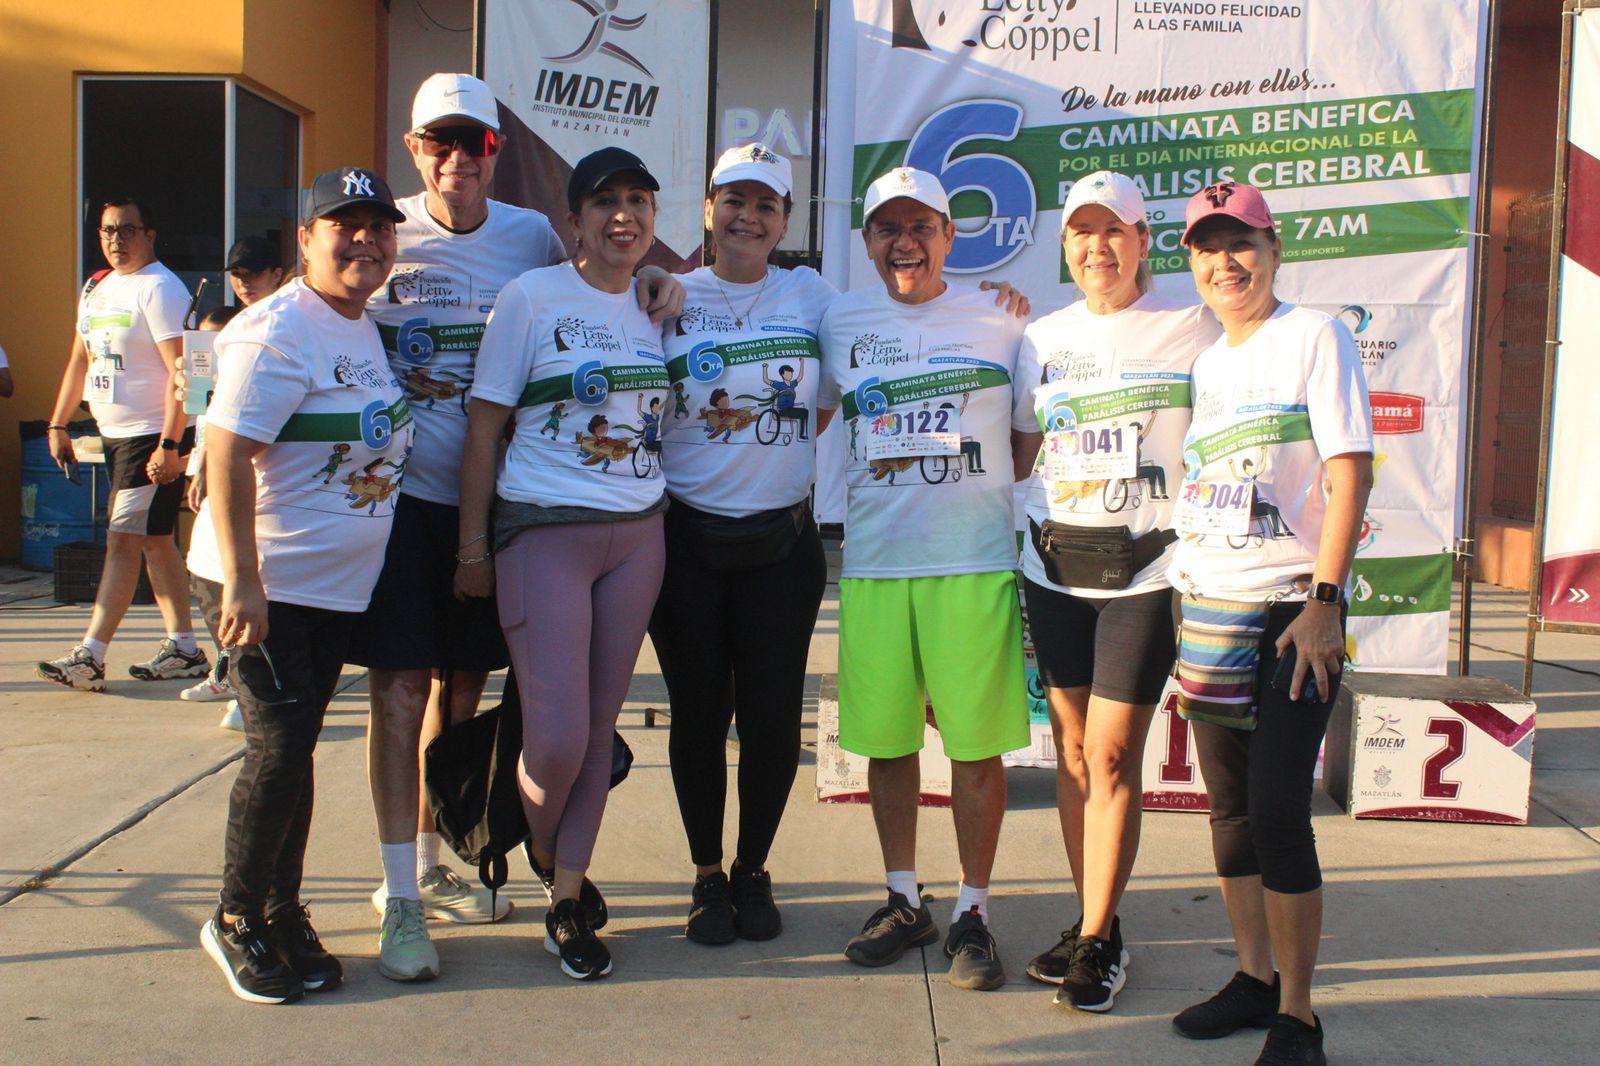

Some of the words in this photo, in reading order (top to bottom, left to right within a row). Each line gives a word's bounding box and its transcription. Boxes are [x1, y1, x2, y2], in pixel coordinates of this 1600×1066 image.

[1134, 1, 1216, 16] LLEVANDO
[1221, 4, 1301, 18] FELICIDAD
[1133, 18, 1144, 30] A
[1149, 19, 1178, 31] LAS
[1183, 20, 1243, 33] FAMILIA
[980, 15, 1102, 61] Coppel
[534, 69, 660, 118] IMDEM
[1061, 85, 1098, 112] De
[1103, 83, 1131, 108] la
[1134, 83, 1205, 105] mano
[1210, 78, 1254, 98] con
[532, 103, 567, 116] INSTITUTO
[568, 109, 606, 121] MUNICIPAL
[608, 114, 619, 123] DEL
[620, 116, 651, 127] DEPORTE
[1059, 114, 1241, 151] CAMINATA
[1251, 99, 1416, 134] BENEFICA
[1059, 156, 1100, 172] POR
[1109, 154, 1129, 168] EL
[1136, 150, 1171, 166] DIA
[1178, 134, 1353, 162] INTERNACIONAL
[1359, 131, 1386, 147] DE
[1392, 129, 1417, 145] LA
[1248, 150, 1431, 188] CEREBRAL
[1295, 213, 1369, 240] 7AM
[1282, 249, 1300, 258] LOS
[1301, 246, 1345, 257] DEPORTES
[1148, 256, 1184, 271] TRO
[725, 339, 773, 352] CAMINATA
[776, 349, 811, 357] CEREBRAL
[871, 353, 909, 366] Coppel
[611, 367, 650, 377] CAMINATA
[890, 374, 935, 390] CAMINATA
[939, 380, 982, 394] CEREBRAL
[1079, 391, 1126, 407] CAMINATA
[1127, 398, 1170, 412] CEREBRAL
[1370, 404, 1413, 417] amá
[1364, 737, 1405, 748] IMDEM
[1420, 716, 1467, 800] 2
